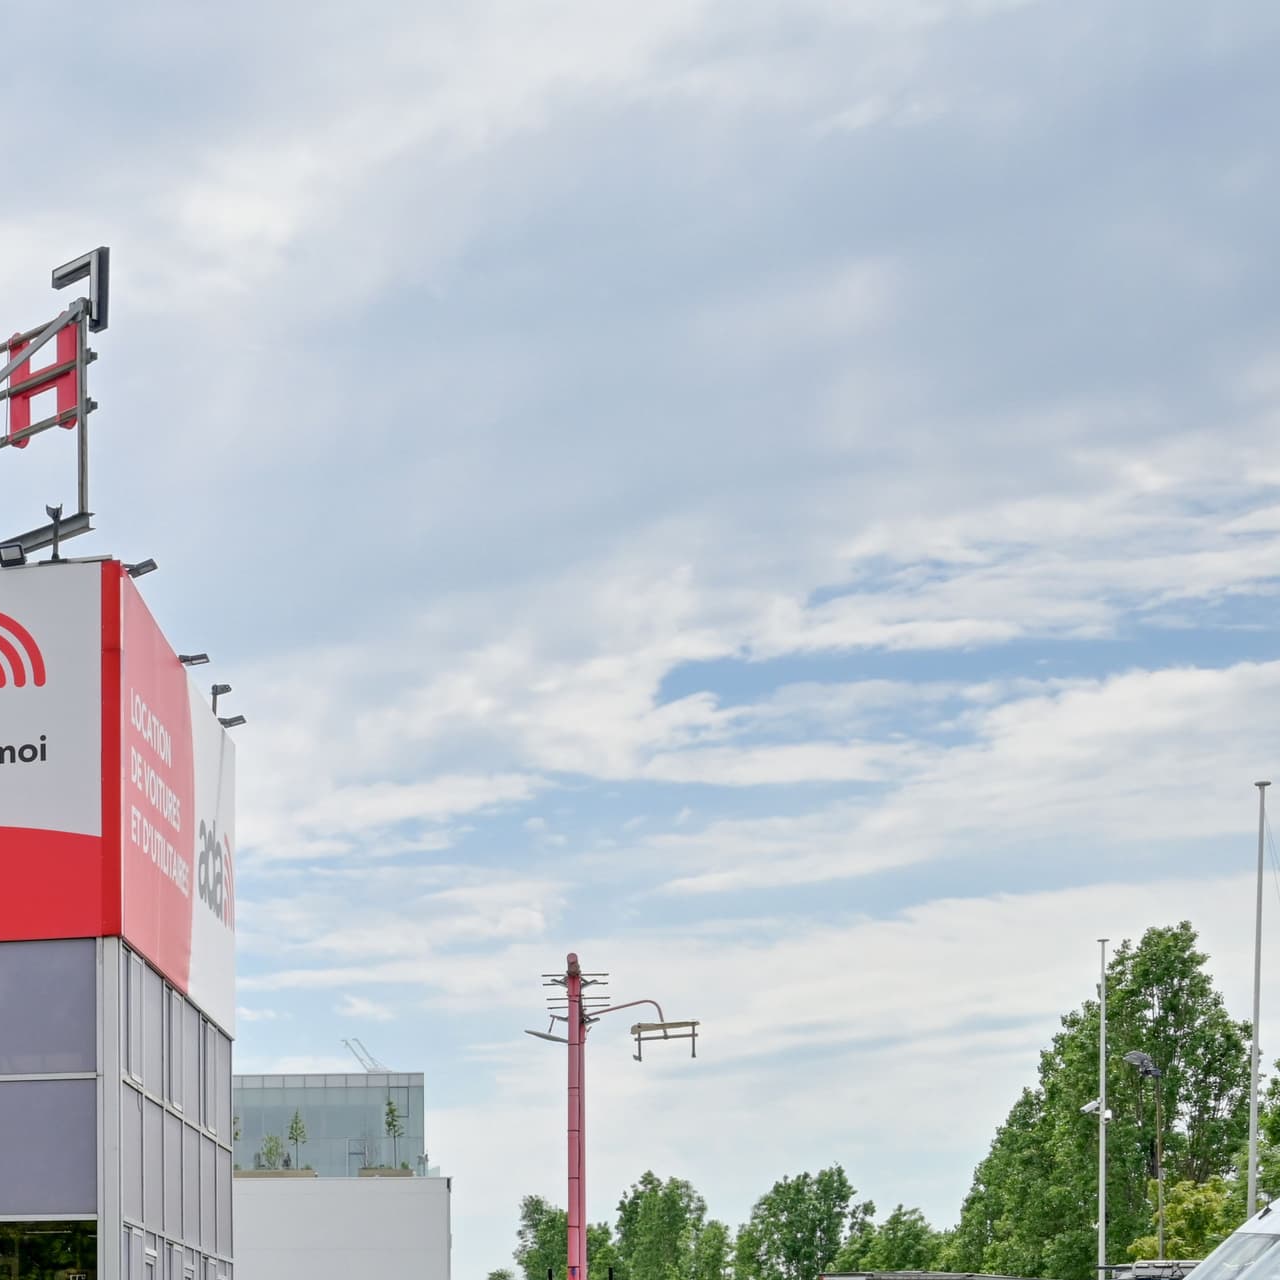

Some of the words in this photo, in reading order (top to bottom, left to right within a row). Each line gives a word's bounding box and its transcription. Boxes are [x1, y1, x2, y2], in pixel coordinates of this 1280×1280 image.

[130, 687, 172, 769] LOCATION
[130, 744, 143, 792] DE
[144, 759, 182, 833] VOITURES
[130, 804, 142, 849] ET
[198, 818, 224, 922] ada
